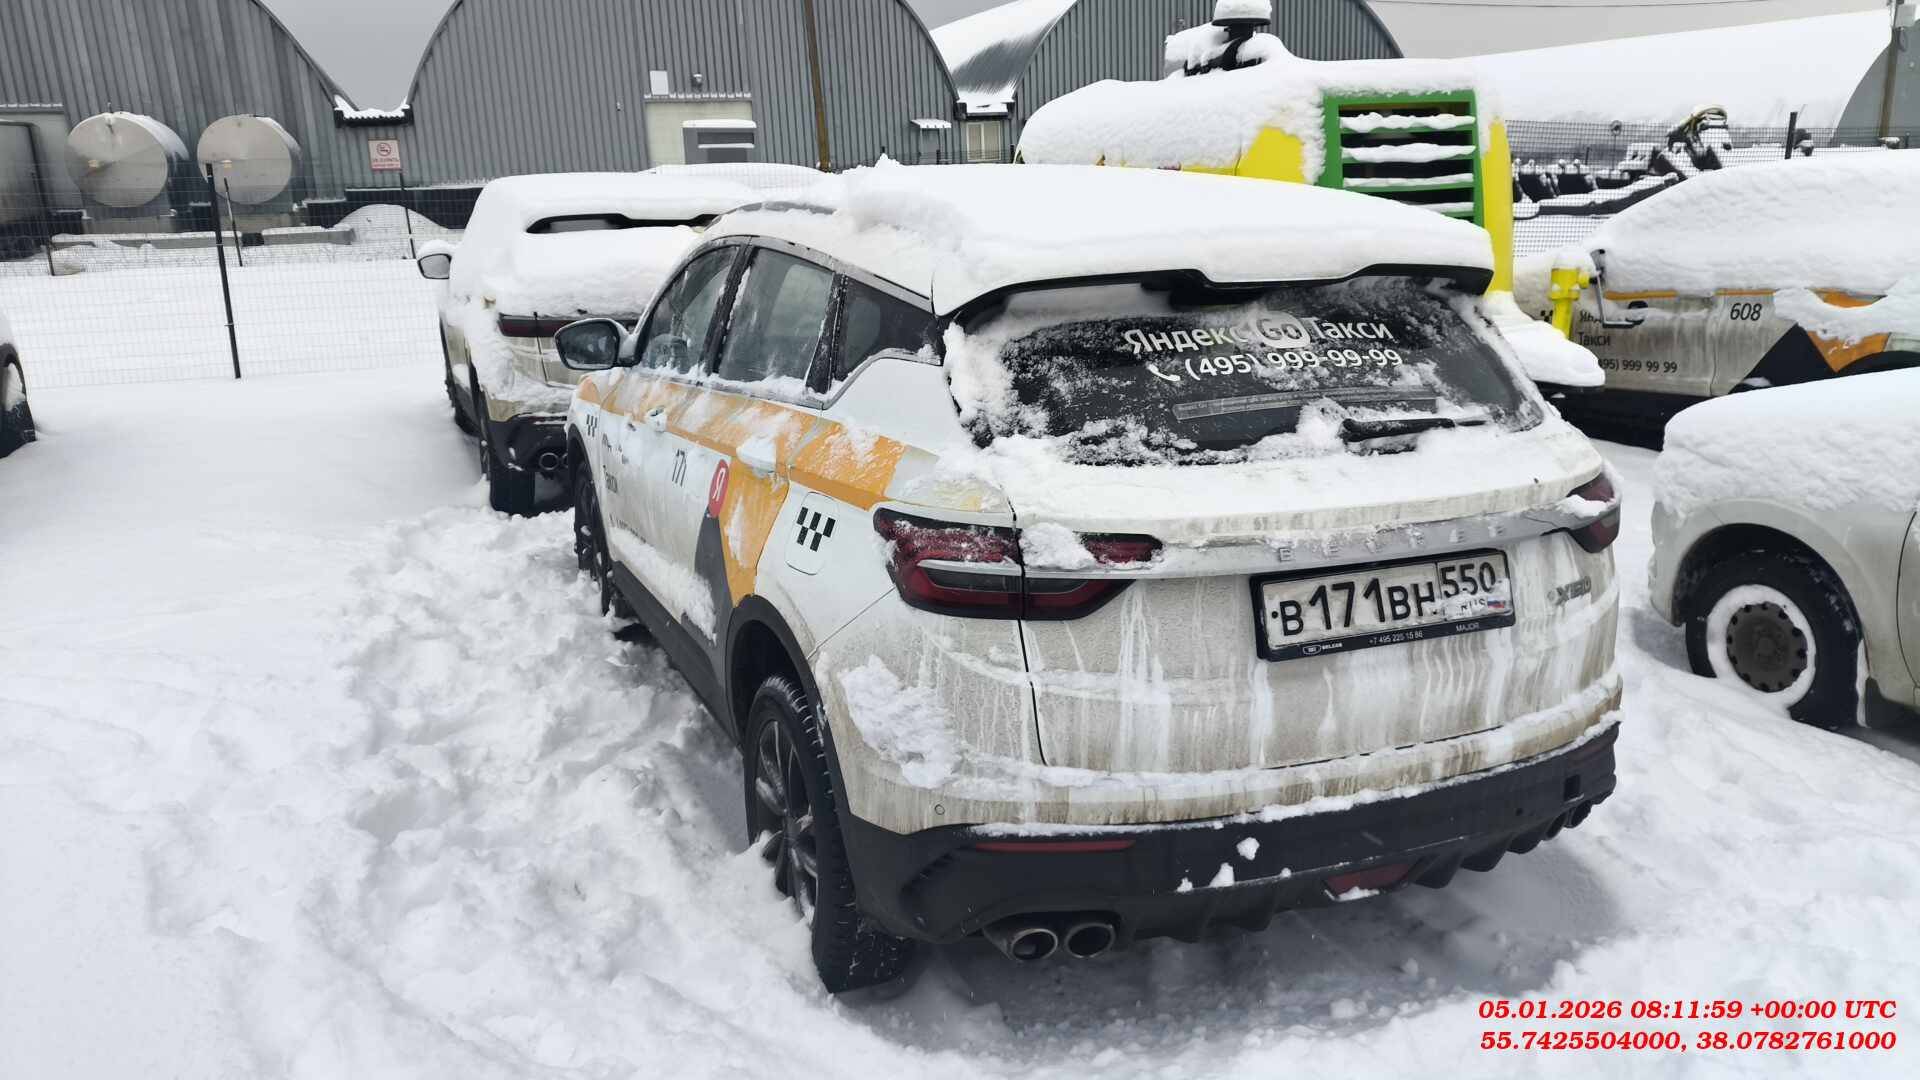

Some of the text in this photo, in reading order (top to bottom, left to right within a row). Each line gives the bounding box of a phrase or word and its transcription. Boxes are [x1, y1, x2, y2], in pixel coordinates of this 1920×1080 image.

[1730, 303, 1762, 321] 608
[1126, 316, 1395, 353] Яндекс Go Такси
[1185, 349, 1402, 381] (495) 999-99-99
[1623, 359, 1642, 371] 999
[1646, 361, 1660, 373] 99
[1663, 362, 1678, 373] 99
[712, 467, 726, 502] Я
[1441, 562, 1496, 599] 550
